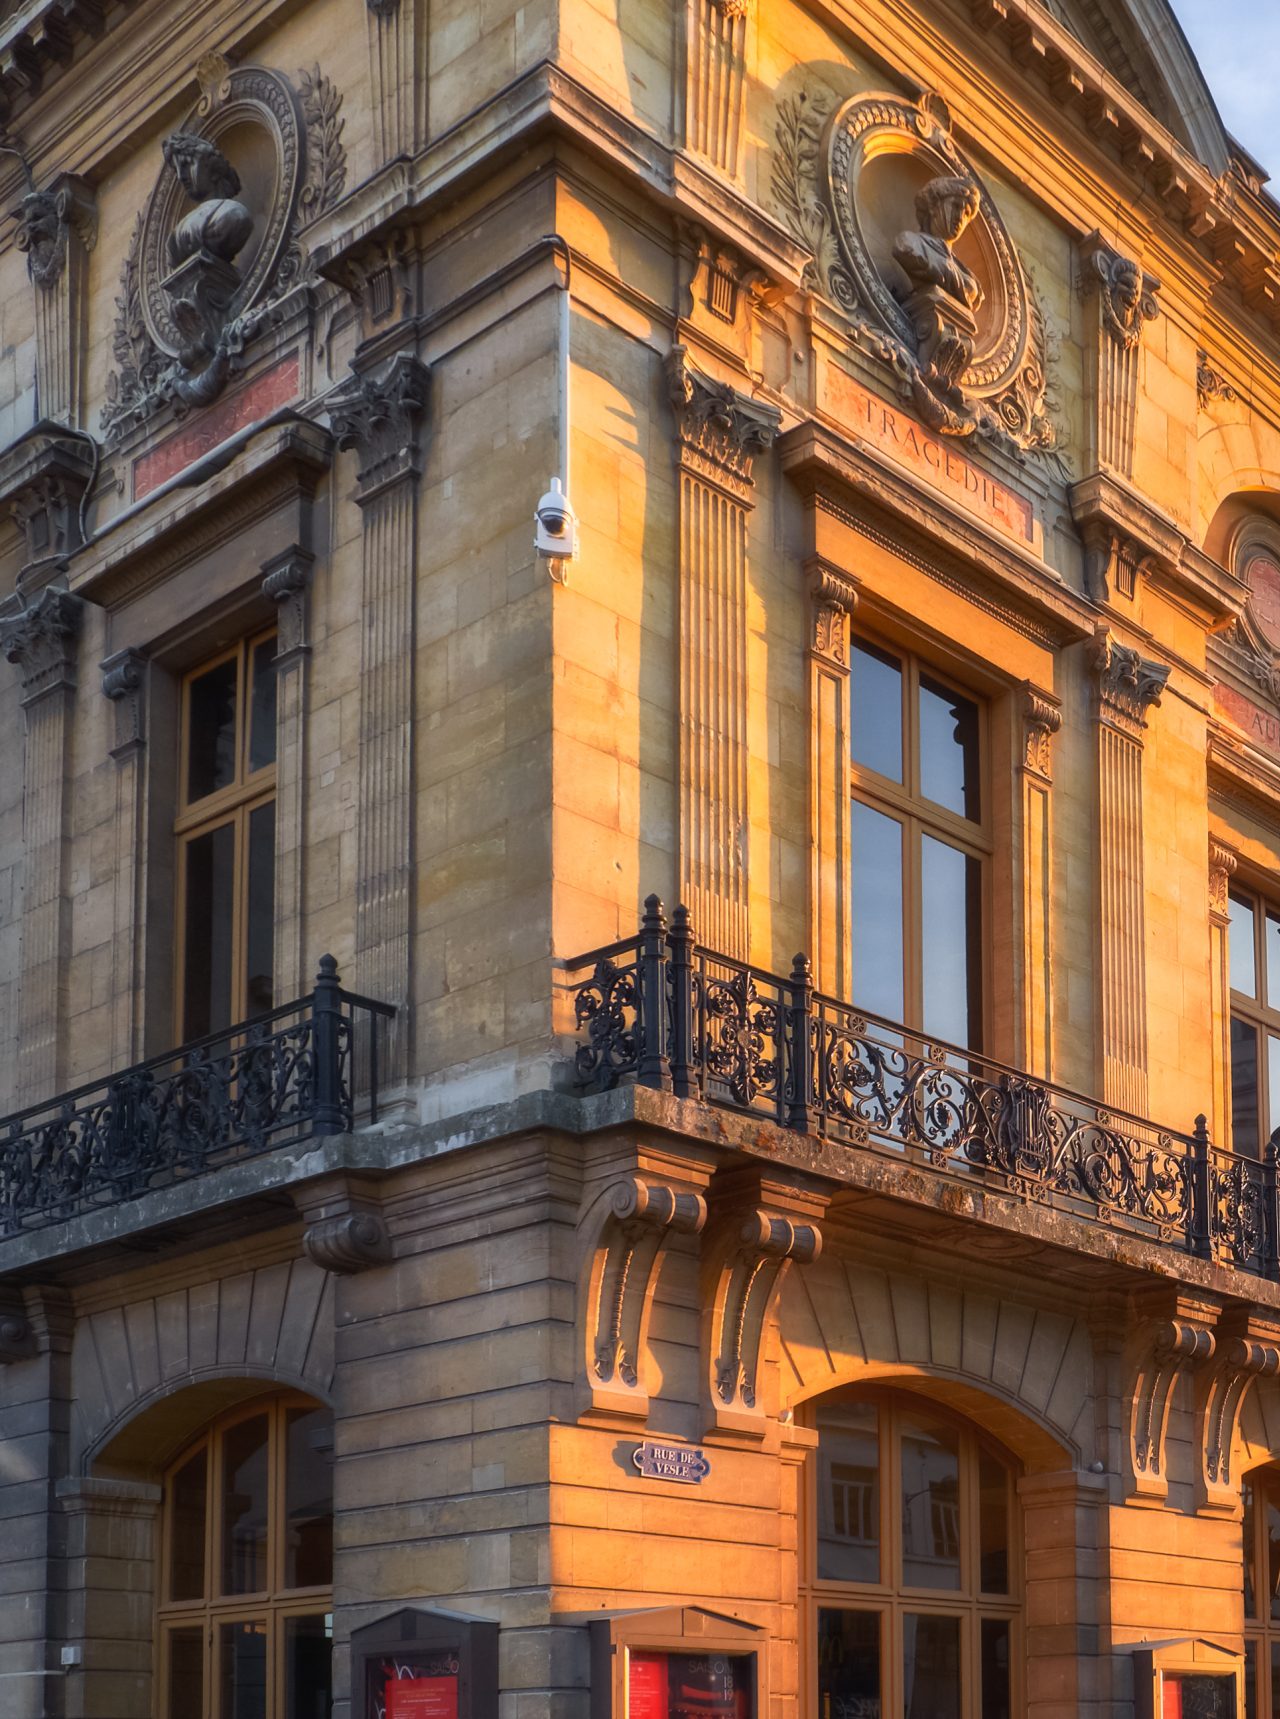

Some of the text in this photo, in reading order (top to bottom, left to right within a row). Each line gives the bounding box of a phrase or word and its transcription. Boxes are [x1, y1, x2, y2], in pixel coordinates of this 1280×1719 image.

[860, 393, 1004, 513] TRAGEDIE
[653, 1448, 695, 1465] RUE DE
[656, 1462, 690, 1478] VESLE
[688, 1660, 734, 1674] SAISON
[723, 1675, 734, 1689] 18
[723, 1689, 734, 1702] 19
